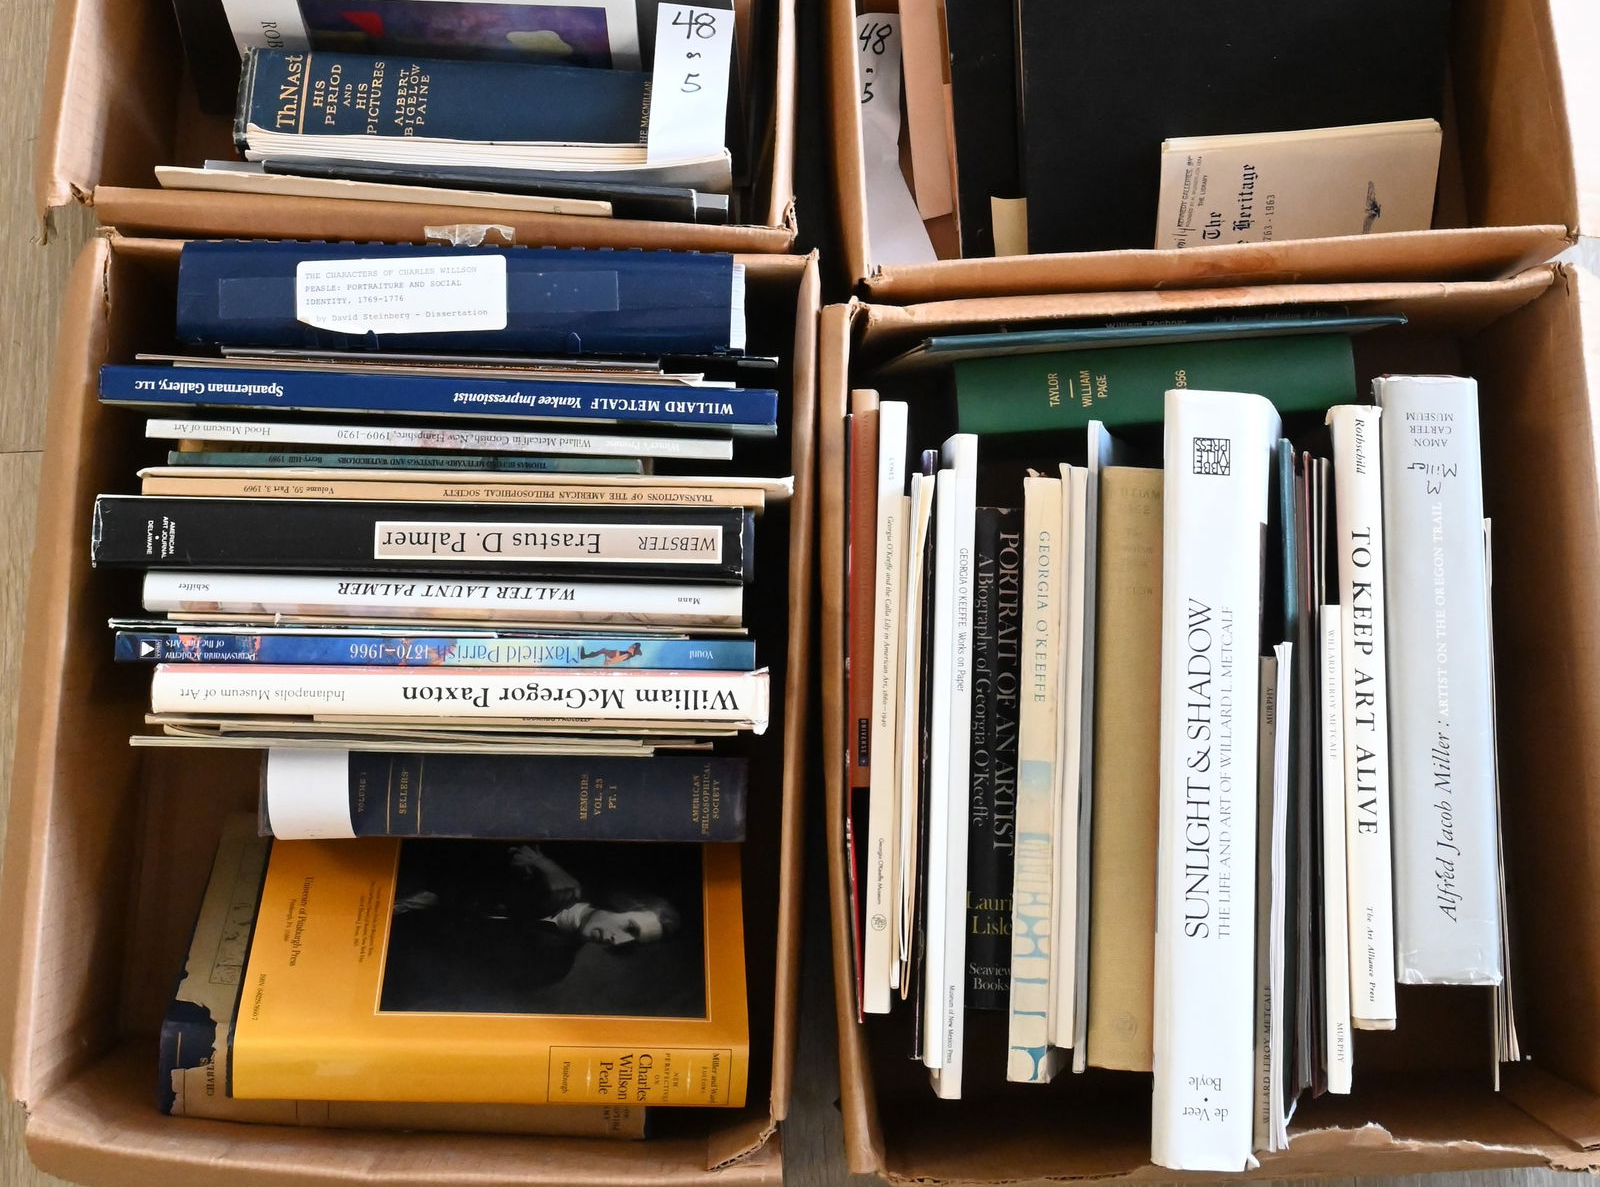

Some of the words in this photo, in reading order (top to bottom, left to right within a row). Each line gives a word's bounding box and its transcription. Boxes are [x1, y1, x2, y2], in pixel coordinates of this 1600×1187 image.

[672, 10, 716, 40] 48
[859, 23, 892, 55] 48
[314, 80, 325, 107] HIS
[681, 73, 702, 93] 5
[861, 83, 874, 104] 5
[325, 64, 342, 125] PERIOD
[343, 84, 352, 107] AND
[356, 82, 368, 109] HIS
[367, 61, 385, 134] PICTURES
[394, 69, 410, 125] ALBERT
[405, 64, 419, 136] BIGELOW
[416, 75, 430, 125] PAINE
[1232, 164, 1258, 231] Heritage
[1202, 211, 1226, 240] The
[135, 380, 155, 390] LLC
[158, 380, 205, 394] Gallery,
[208, 382, 284, 397] Spanierman
[453, 391, 536, 408] Impressionist
[538, 395, 582, 409] Yankee
[591, 397, 661, 412] METCALF
[664, 400, 733, 415] WILLARD
[174, 423, 190, 433] Art
[192, 424, 201, 434] of
[203, 424, 242, 435] Museum
[244, 426, 271, 436] Hood
[1409, 426, 1451, 434] CARTER
[1355, 419, 1365, 474] Rothschild
[1414, 438, 1448, 447] AMON
[1407, 462, 1457, 477] Miller
[442, 488, 480, 497] SOCIETY
[484, 489, 555, 498] PHILOSOPHICAL
[559, 491, 605, 500] AMERICAN
[609, 492, 628, 500] THE
[631, 493, 643, 501] OF
[647, 493, 713, 502] TRANSACTIONS
[381, 531, 467, 554] Palmer
[476, 532, 503, 553] D.
[512, 532, 601, 554] Erastus
[638, 536, 716, 551] WEBSTER
[1351, 527, 1372, 568] TO
[978, 553, 992, 568] A
[1037, 531, 1049, 610] GEORGIA
[178, 583, 210, 591] Schiffer
[337, 582, 416, 597] PALMER
[420, 583, 490, 600] LAUNT
[497, 587, 575, 601] WALTER
[999, 532, 1019, 668] PORTRAIT
[974, 572, 994, 652] Biography
[1352, 580, 1373, 655] KEEP
[1221, 606, 1233, 677] METCALF
[976, 658, 991, 676] of
[1034, 619, 1048, 703] O'KEEFFE
[1187, 598, 1212, 741] SHADOW
[180, 688, 200, 700] Art
[204, 689, 217, 701] of
[221, 689, 270, 700] Museum
[275, 687, 345, 701] Indianapolis
[401, 685, 490, 709] Paxton
[499, 683, 624, 709] McGregor
[997, 672, 1016, 709] OF
[1221, 681, 1233, 692] L.
[635, 689, 739, 710] William
[1353, 668, 1376, 732] ART
[972, 678, 993, 745] Georgia
[993, 716, 1016, 753] AN
[1220, 695, 1233, 768] WILLARD
[1187, 746, 1211, 773] &
[1220, 772, 1232, 792] OF
[1356, 744, 1378, 834] ALIVE
[993, 758, 1014, 856] ARTIST
[1219, 796, 1232, 828] ART
[1185, 776, 1210, 939] SUNLIGHT
[1219, 831, 1232, 868] AND
[1219, 872, 1232, 902] LIFE
[1219, 906, 1231, 939] THE
[1366, 906, 1374, 922] The
[1367, 943, 1376, 978] Alliance
[1368, 982, 1376, 1002] Press
[598, 1061, 614, 1095] Peale
[617, 1054, 634, 1100] Willson
[636, 1054, 652, 1102] Charles
[1188, 1077, 1222, 1091] Boyle
[1183, 1107, 1218, 1121] Veer
[1220, 1108, 1229, 1121] de
